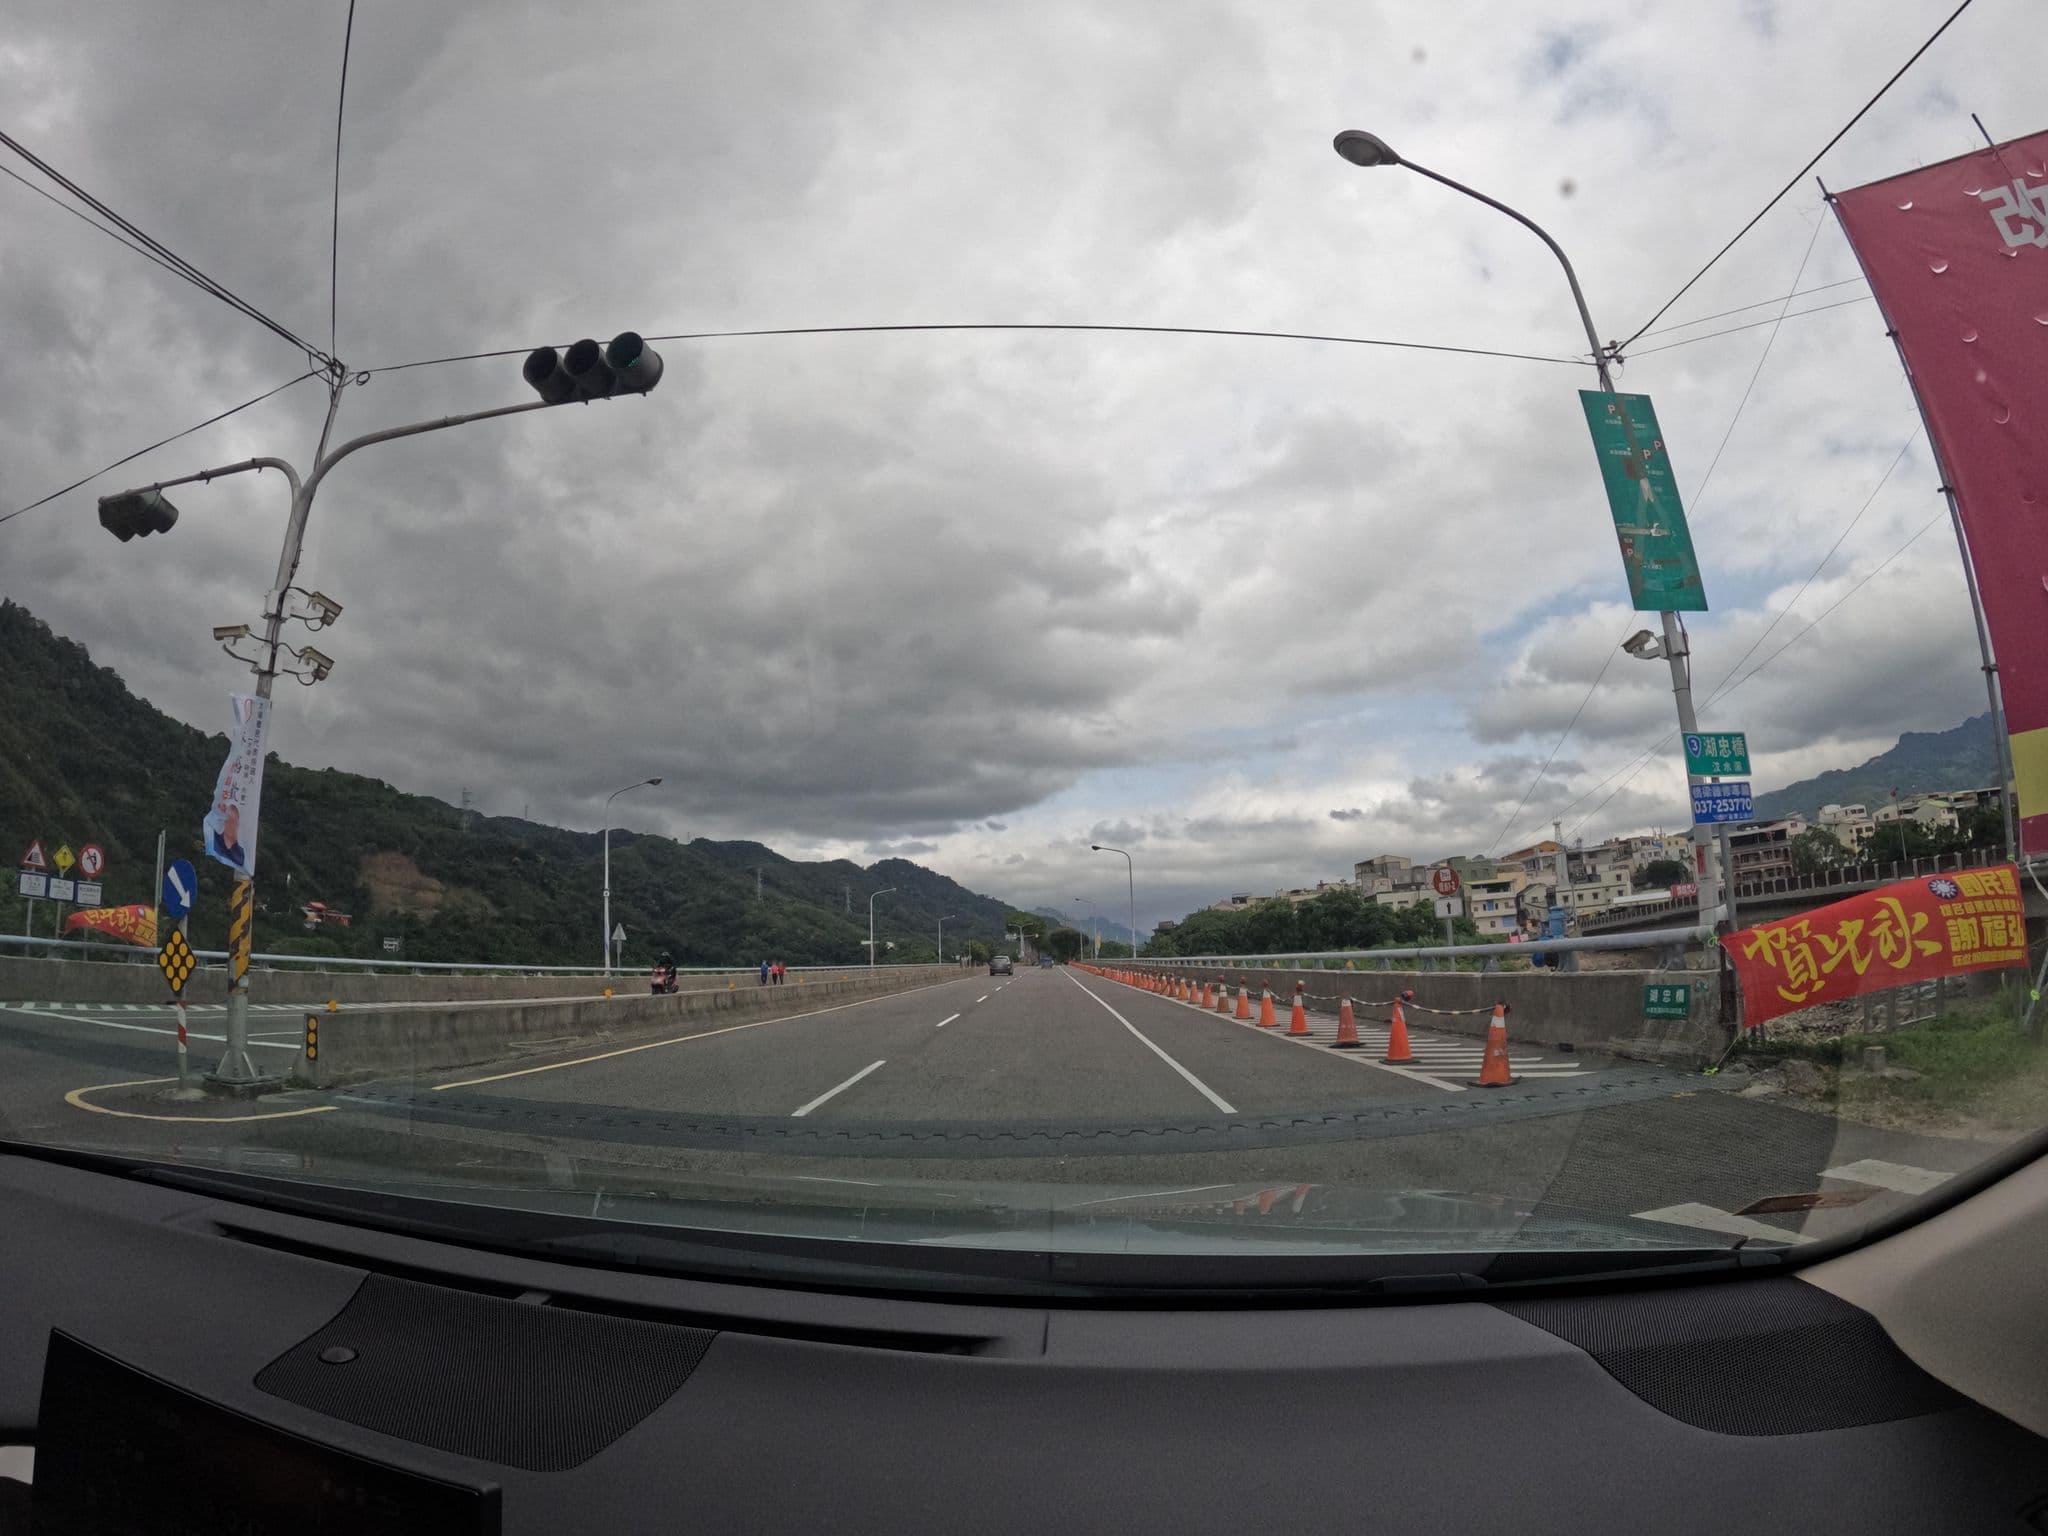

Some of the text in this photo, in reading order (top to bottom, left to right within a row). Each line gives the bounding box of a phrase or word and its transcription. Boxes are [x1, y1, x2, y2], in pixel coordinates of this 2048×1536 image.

[1607, 404, 1616, 414] P
[1653, 440, 1662, 451] P
[1643, 449, 1652, 460] P
[1690, 739, 1699, 751] 3
[1702, 735, 1745, 758] 湖忠橋
[1694, 797, 1752, 815] 037-253770
[1946, 914, 2025, 952] 謝福弘
